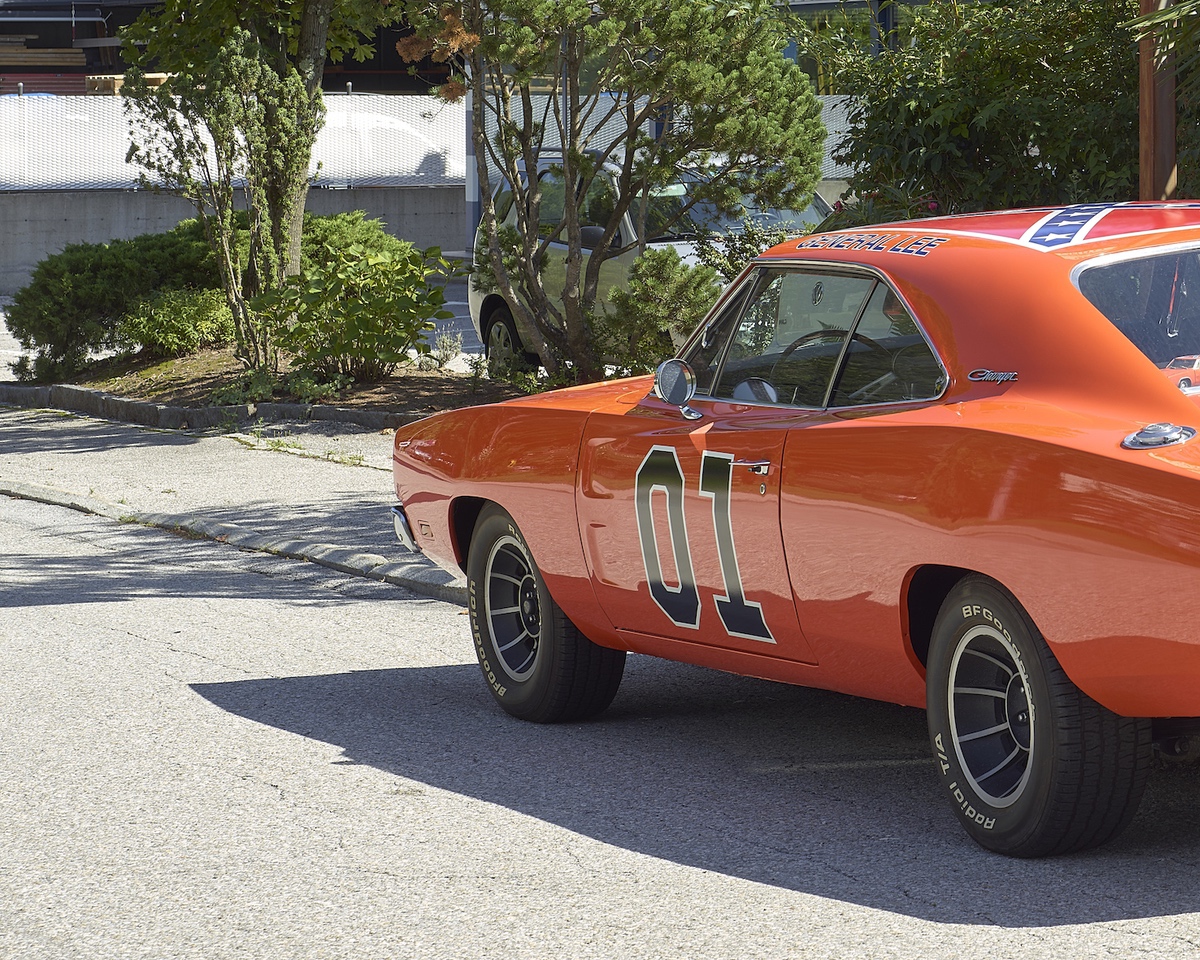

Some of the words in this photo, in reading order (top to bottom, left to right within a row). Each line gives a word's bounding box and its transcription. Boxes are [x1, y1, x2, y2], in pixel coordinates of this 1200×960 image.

[796, 233, 900, 252] GENERAL
[887, 235, 951, 258] LEE
[634, 444, 777, 644] 01
[934, 733, 951, 776] T/A
[949, 781, 996, 830] Radial
